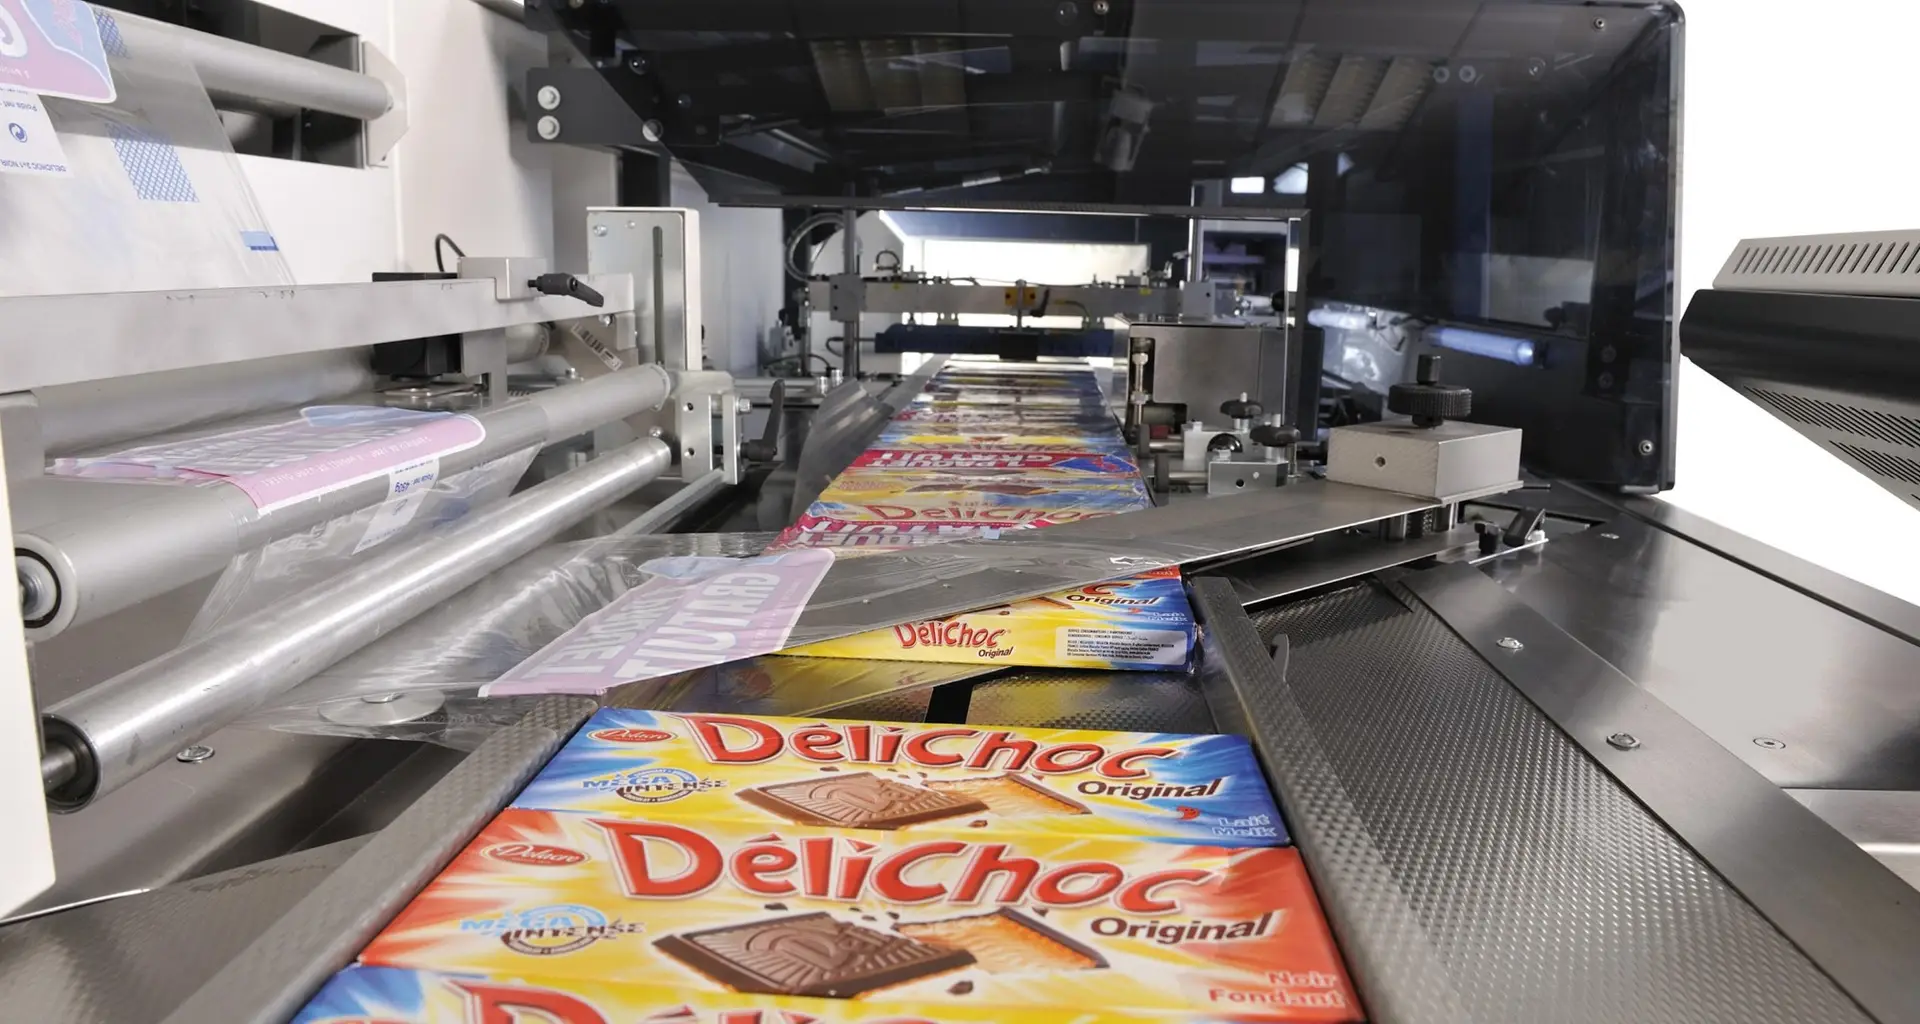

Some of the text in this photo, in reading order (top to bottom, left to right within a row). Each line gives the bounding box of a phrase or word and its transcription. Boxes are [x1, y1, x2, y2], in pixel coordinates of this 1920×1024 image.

[1066, 594, 1160, 606] Original
[978, 646, 1013, 659] Original
[1078, 779, 1220, 799] Original
[1218, 812, 1270, 827] Lait
[1212, 825, 1278, 837] Melk
[1090, 912, 1273, 945] Original
[1267, 970, 1337, 987] Noir
[1208, 987, 1344, 1009] Fondant
